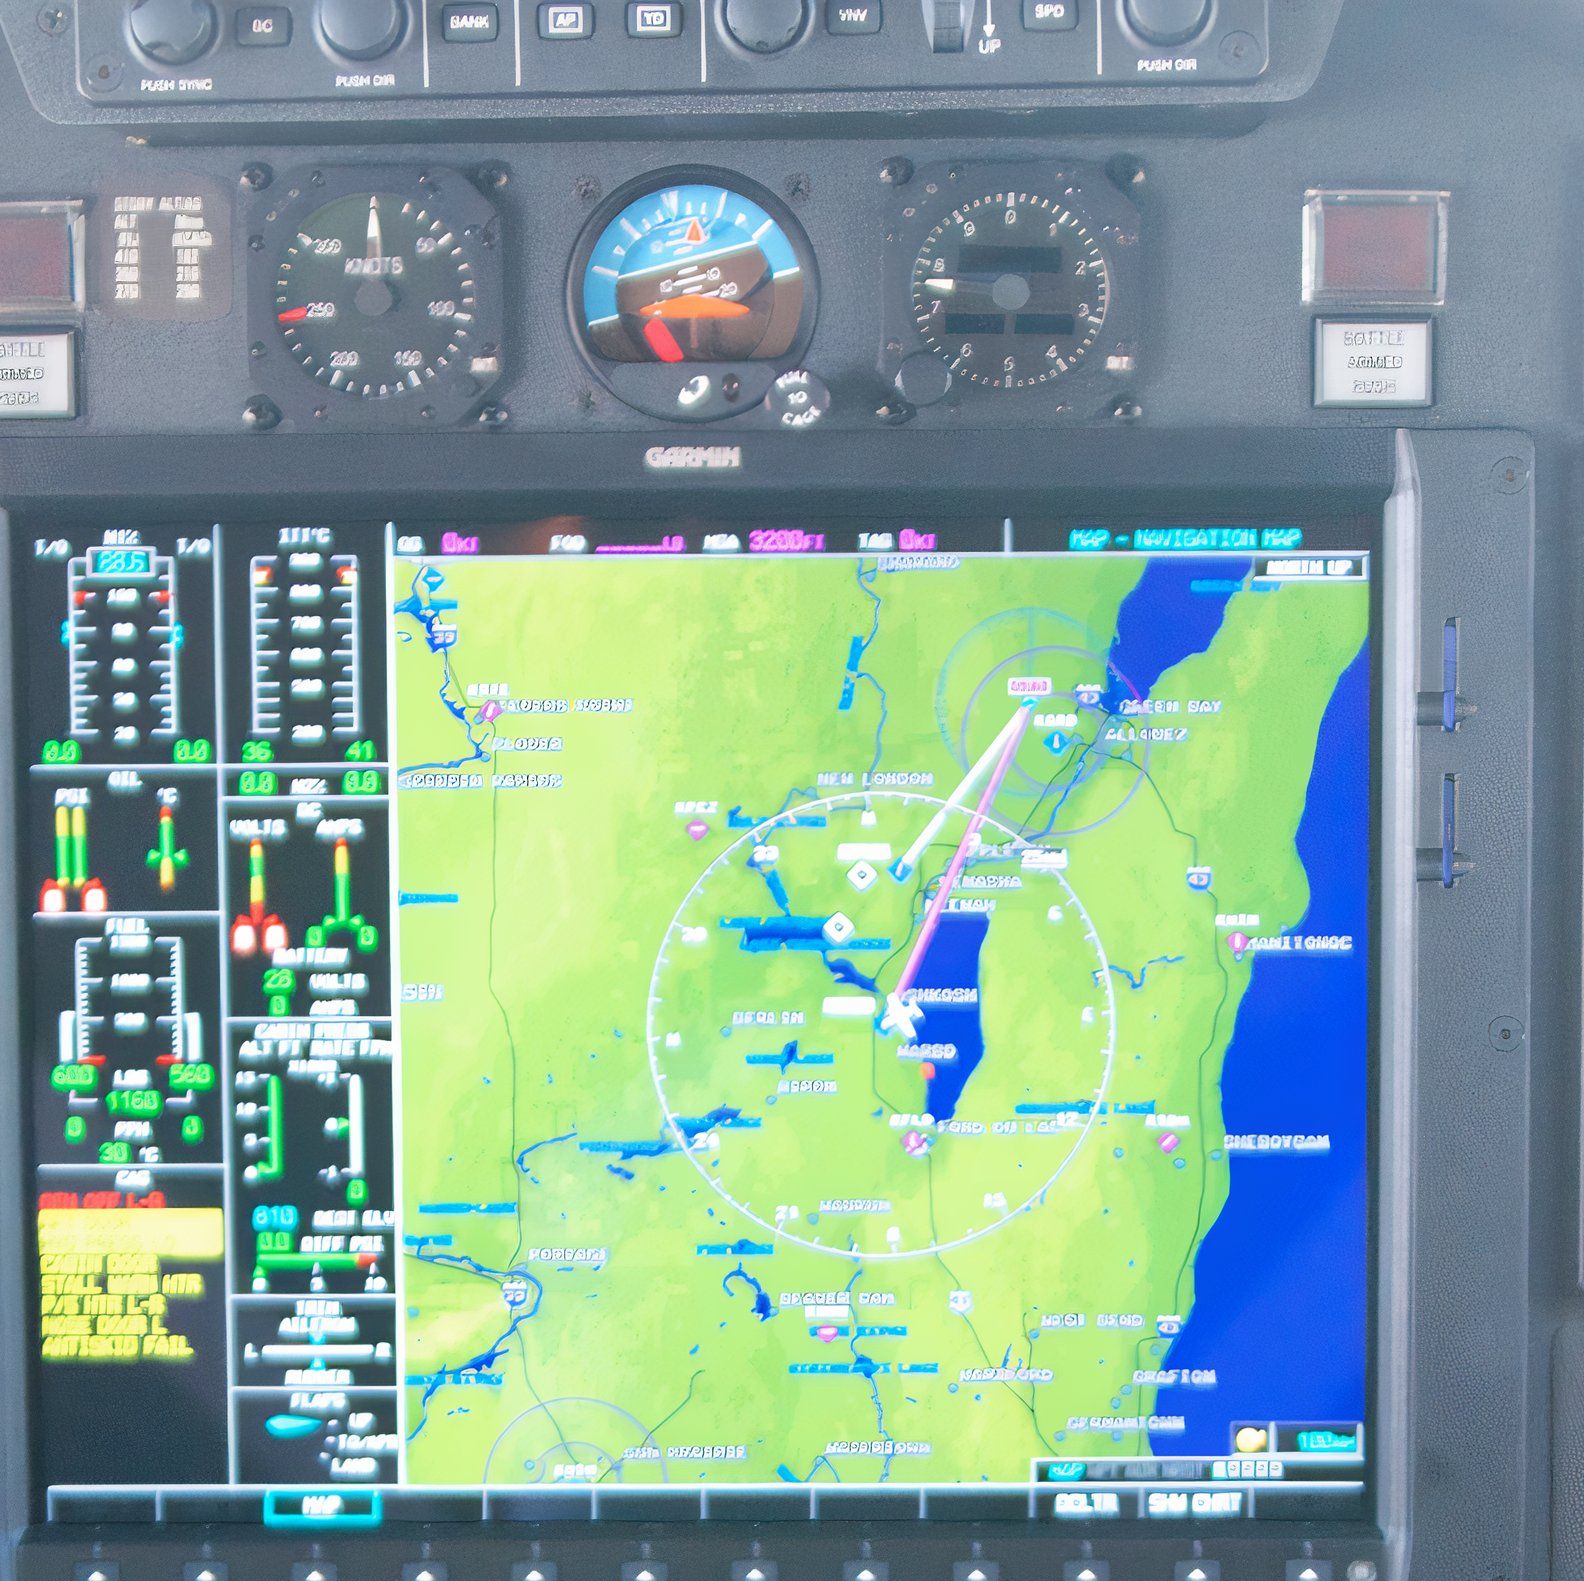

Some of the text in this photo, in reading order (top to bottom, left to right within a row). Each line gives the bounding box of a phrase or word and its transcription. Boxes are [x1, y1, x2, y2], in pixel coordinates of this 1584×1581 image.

[979, 39, 1000, 54] UP
[344, 257, 403, 276] KNOTS
[1075, 260, 1086, 276] 2
[645, 446, 742, 468] GARMIN
[345, 740, 376, 761] 41
